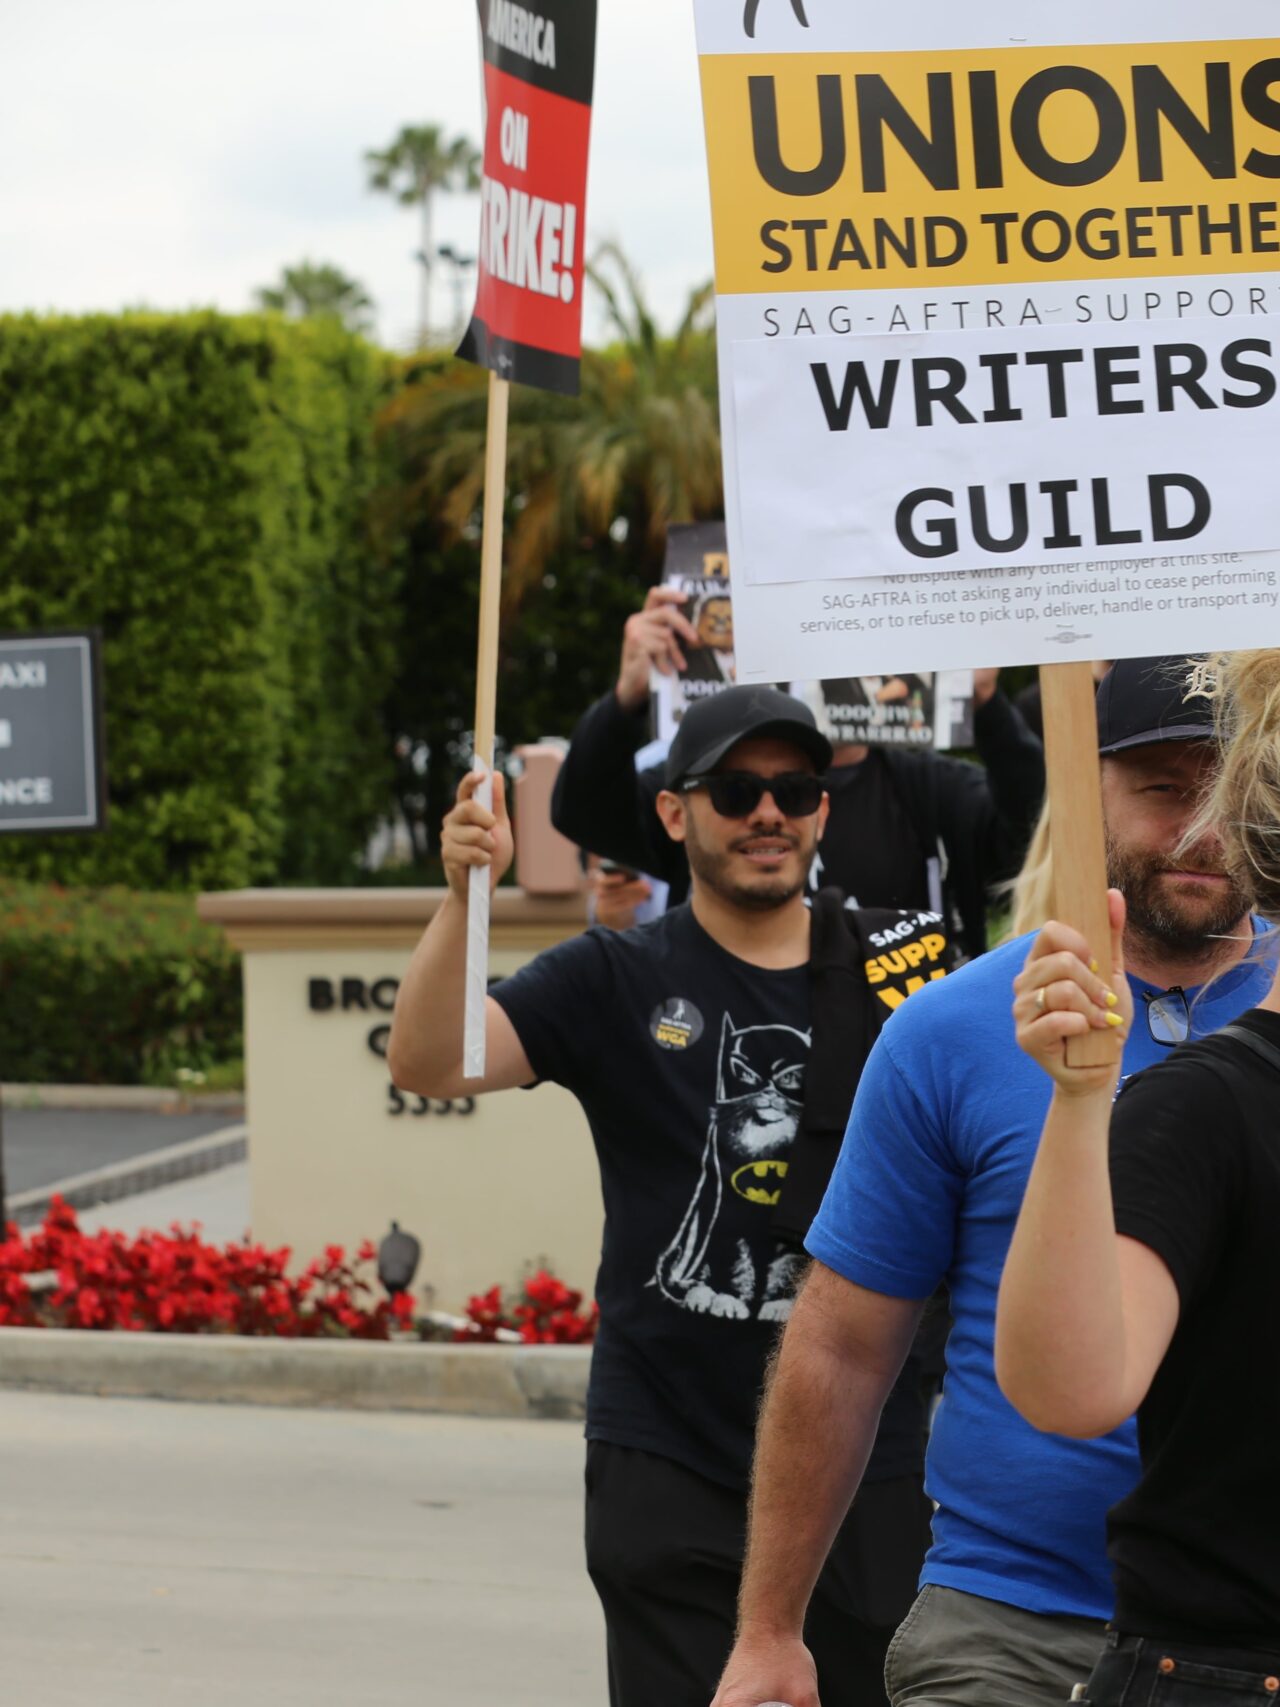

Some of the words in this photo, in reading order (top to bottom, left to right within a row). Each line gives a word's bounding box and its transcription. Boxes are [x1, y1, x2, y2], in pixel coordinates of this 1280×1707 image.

[500, 106, 528, 171] ON
[759, 216, 968, 273] STAND
[763, 296, 1042, 337] SAG-AFTRA
[810, 338, 1277, 432] WRITERS
[894, 472, 1212, 558] GUILD
[822, 590, 912, 610] SAG-AFTRA
[915, 589, 927, 604] is
[932, 587, 958, 603] not
[961, 585, 1012, 603] asking
[1015, 583, 1042, 600] any
[1046, 575, 1121, 597] individual
[1124, 576, 1142, 591] to
[1145, 574, 1187, 590] cease
[1192, 569, 1276, 590] performing
[883, 573, 905, 585] No
[909, 569, 966, 586] dispute
[970, 566, 1004, 579] with
[1008, 565, 1034, 580] any
[1039, 562, 1081, 575] other
[1085, 556, 1156, 574] employer
[1160, 556, 1176, 568] at
[1179, 553, 1208, 567] this
[1211, 551, 1243, 564] site.
[800, 616, 865, 633] services,
[868, 615, 885, 629] or
[888, 612, 905, 627] to
[908, 609, 954, 626] refuse
[960, 609, 976, 623] to
[980, 604, 1011, 625] pick
[1015, 607, 1039, 622] up,
[1043, 599, 1098, 618] deliver,
[1102, 596, 1154, 614] handle
[1157, 598, 1173, 611] or
[1177, 591, 1247, 612] transport
[1252, 590, 1278, 607] any
[865, 933, 947, 976] SUPP
